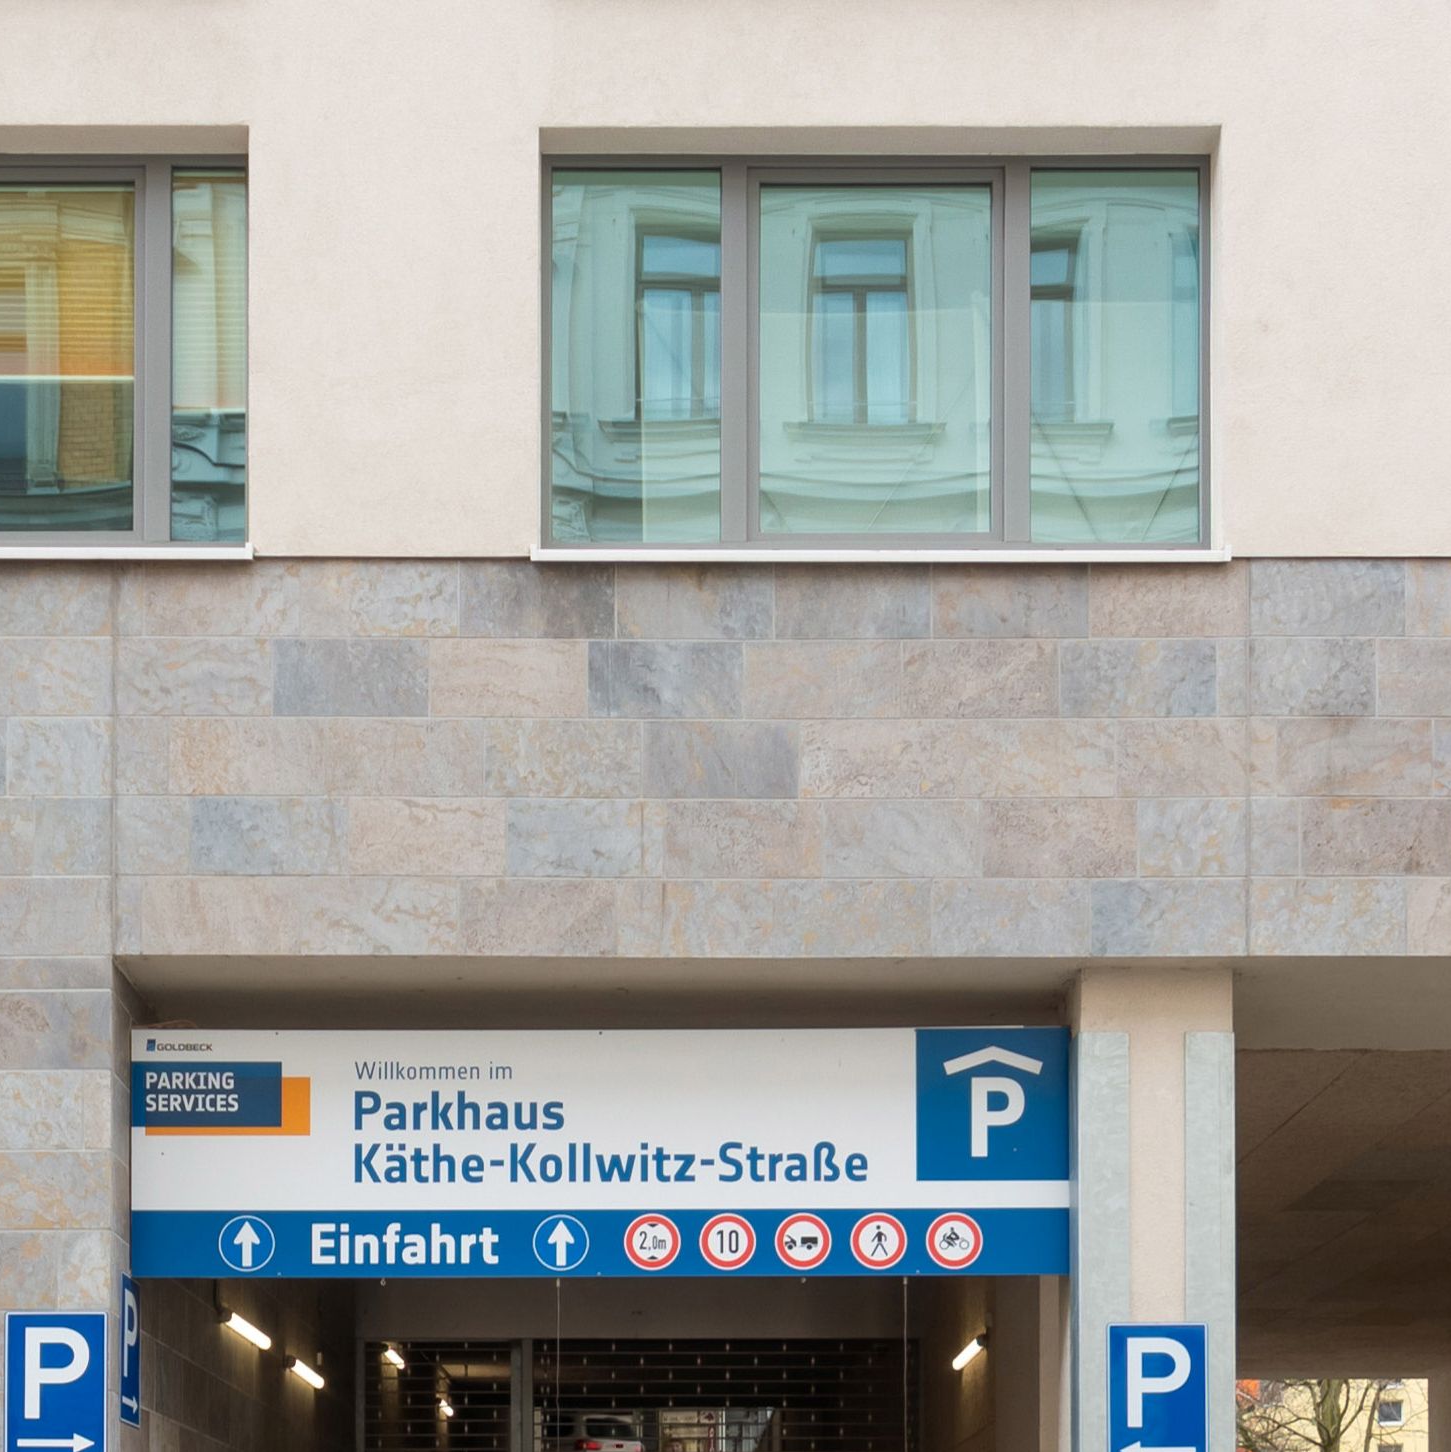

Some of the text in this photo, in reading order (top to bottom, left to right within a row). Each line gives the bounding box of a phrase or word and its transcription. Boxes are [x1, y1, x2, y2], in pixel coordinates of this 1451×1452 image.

[156, 1043, 213, 1052] GOLDBECK
[145, 1072, 235, 1090] PARKING
[354, 1060, 514, 1081] Willkommen im
[145, 1094, 239, 1112] SERVICES
[354, 1090, 566, 1132] Parkhaus
[970, 1076, 1026, 1158] P
[353, 1140, 869, 1184] Käthe-Kollwitz-Straße
[310, 1222, 500, 1265] Einfahrt
[638, 1230, 667, 1251] 2,0m
[715, 1229, 740, 1254] 10
[124, 1287, 138, 1378] P
[23, 1326, 90, 1420] P
[1126, 1337, 1192, 1428] P
